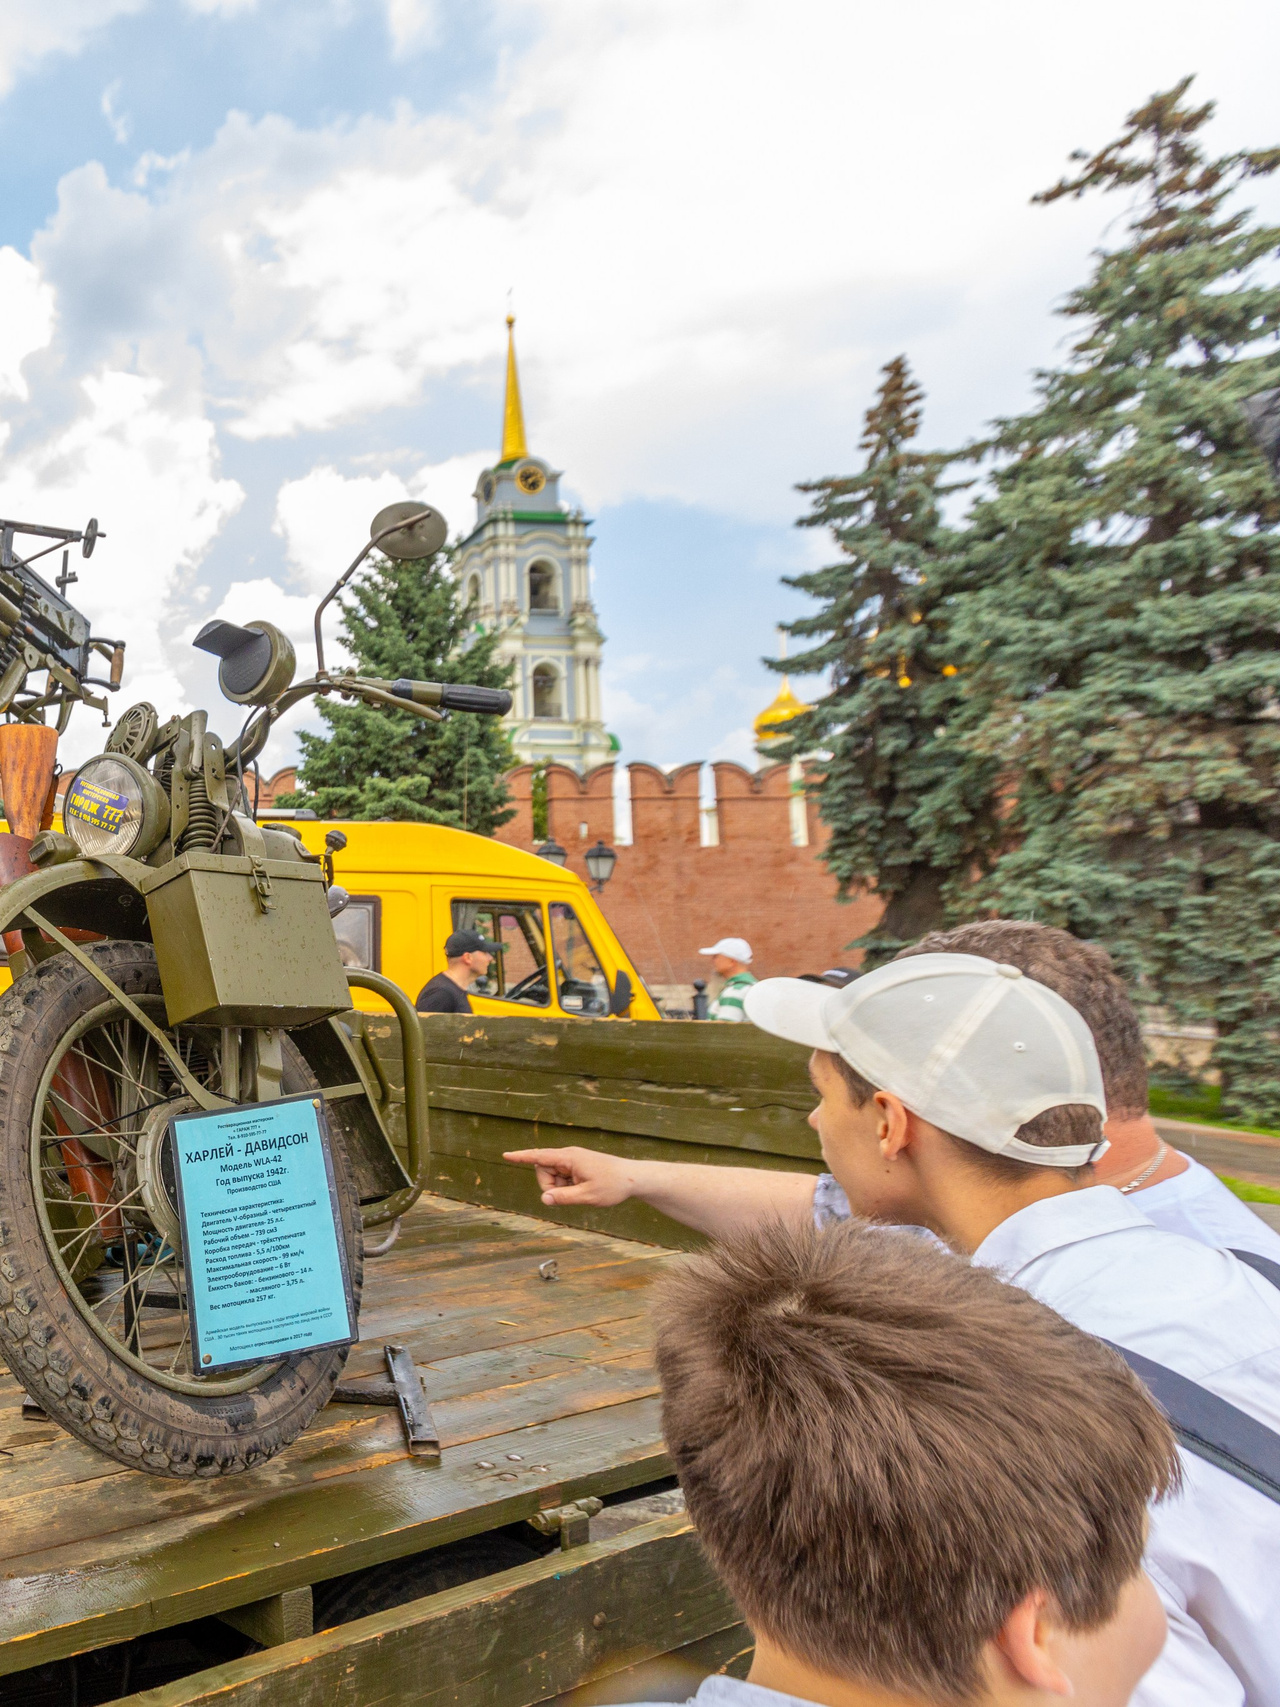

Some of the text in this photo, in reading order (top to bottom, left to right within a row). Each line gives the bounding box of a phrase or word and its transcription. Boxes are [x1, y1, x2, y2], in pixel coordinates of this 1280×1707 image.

[70, 793, 123, 823] ГАРАЖ 777
[186, 1143, 233, 1164] ХАРЛЕЙ
[245, 1132, 308, 1156] ДАВИДСОН
[220, 1155, 282, 1172] Модель WLA-42
[232, 1173, 264, 1183] выпуска
[266, 1168, 289, 1177] 1942г.
[227, 1183, 267, 1195] Производство
[201, 1199, 284, 1218] Техническая характеристика:
[202, 1218, 232, 1228] Двигатель
[233, 1210, 268, 1221] V-образный
[203, 1227, 234, 1236] Мощность
[204, 1236, 228, 1245] Рабочий
[204, 1247, 230, 1255] Коробка
[231, 1242, 256, 1250] передач
[228, 1252, 251, 1260] топлива
[206, 1261, 251, 1273] Максимальная
[253, 1256, 278, 1265] скорость
[207, 1266, 274, 1283] Электрооборудование
[258, 1271, 294, 1282] бензинового
[250, 1284, 280, 1293] масляного
[222, 1298, 255, 1308] мотоцикла
